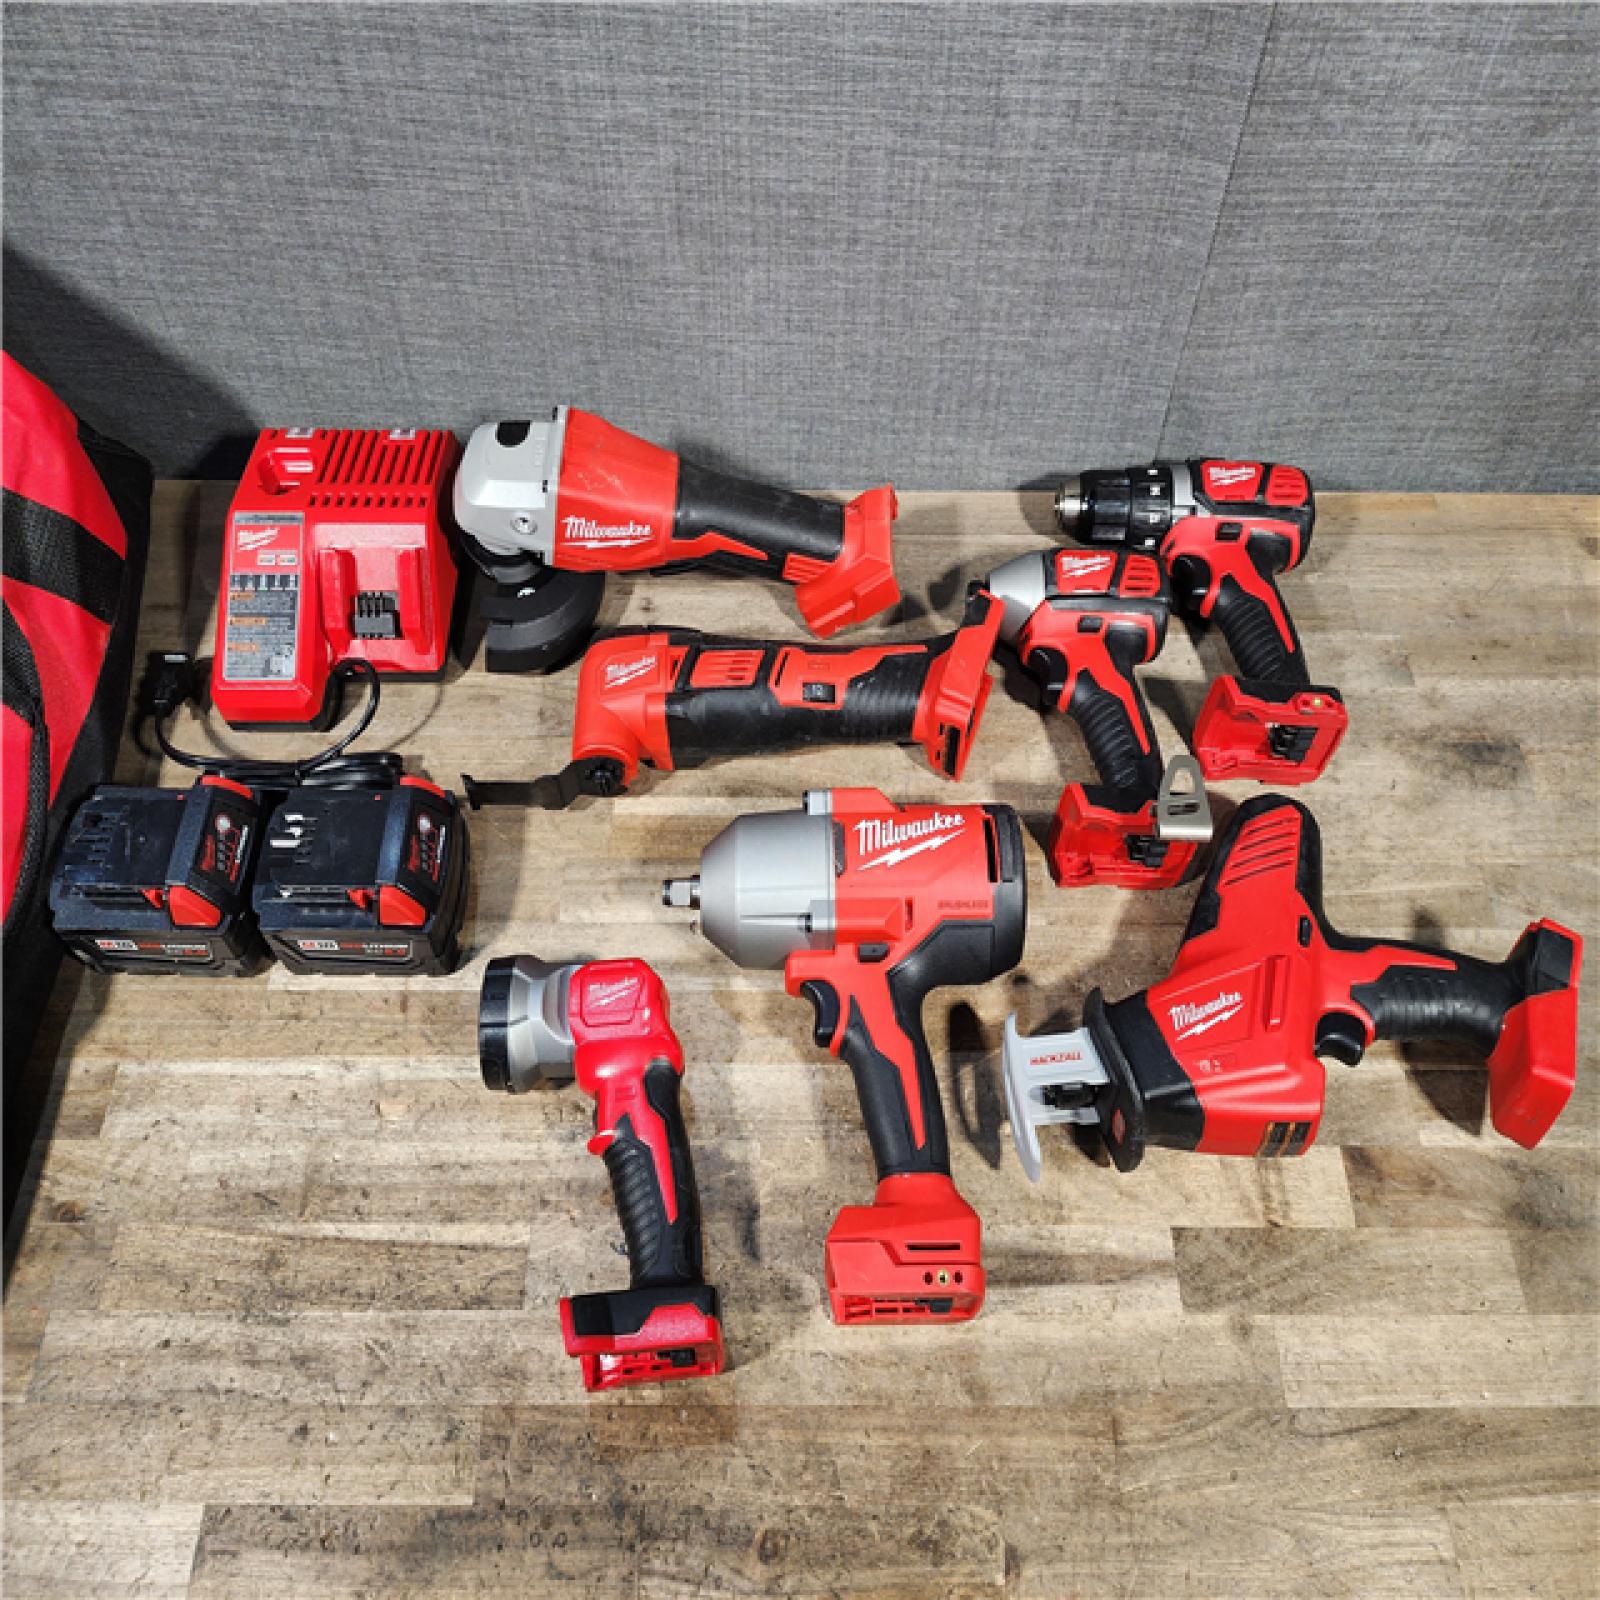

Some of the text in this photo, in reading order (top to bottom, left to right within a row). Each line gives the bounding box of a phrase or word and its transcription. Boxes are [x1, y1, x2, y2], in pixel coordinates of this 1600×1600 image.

[561, 515, 652, 538] Milwaukee
[852, 811, 966, 856] Milwaukee
[1167, 992, 1243, 1031] Milwaukee
